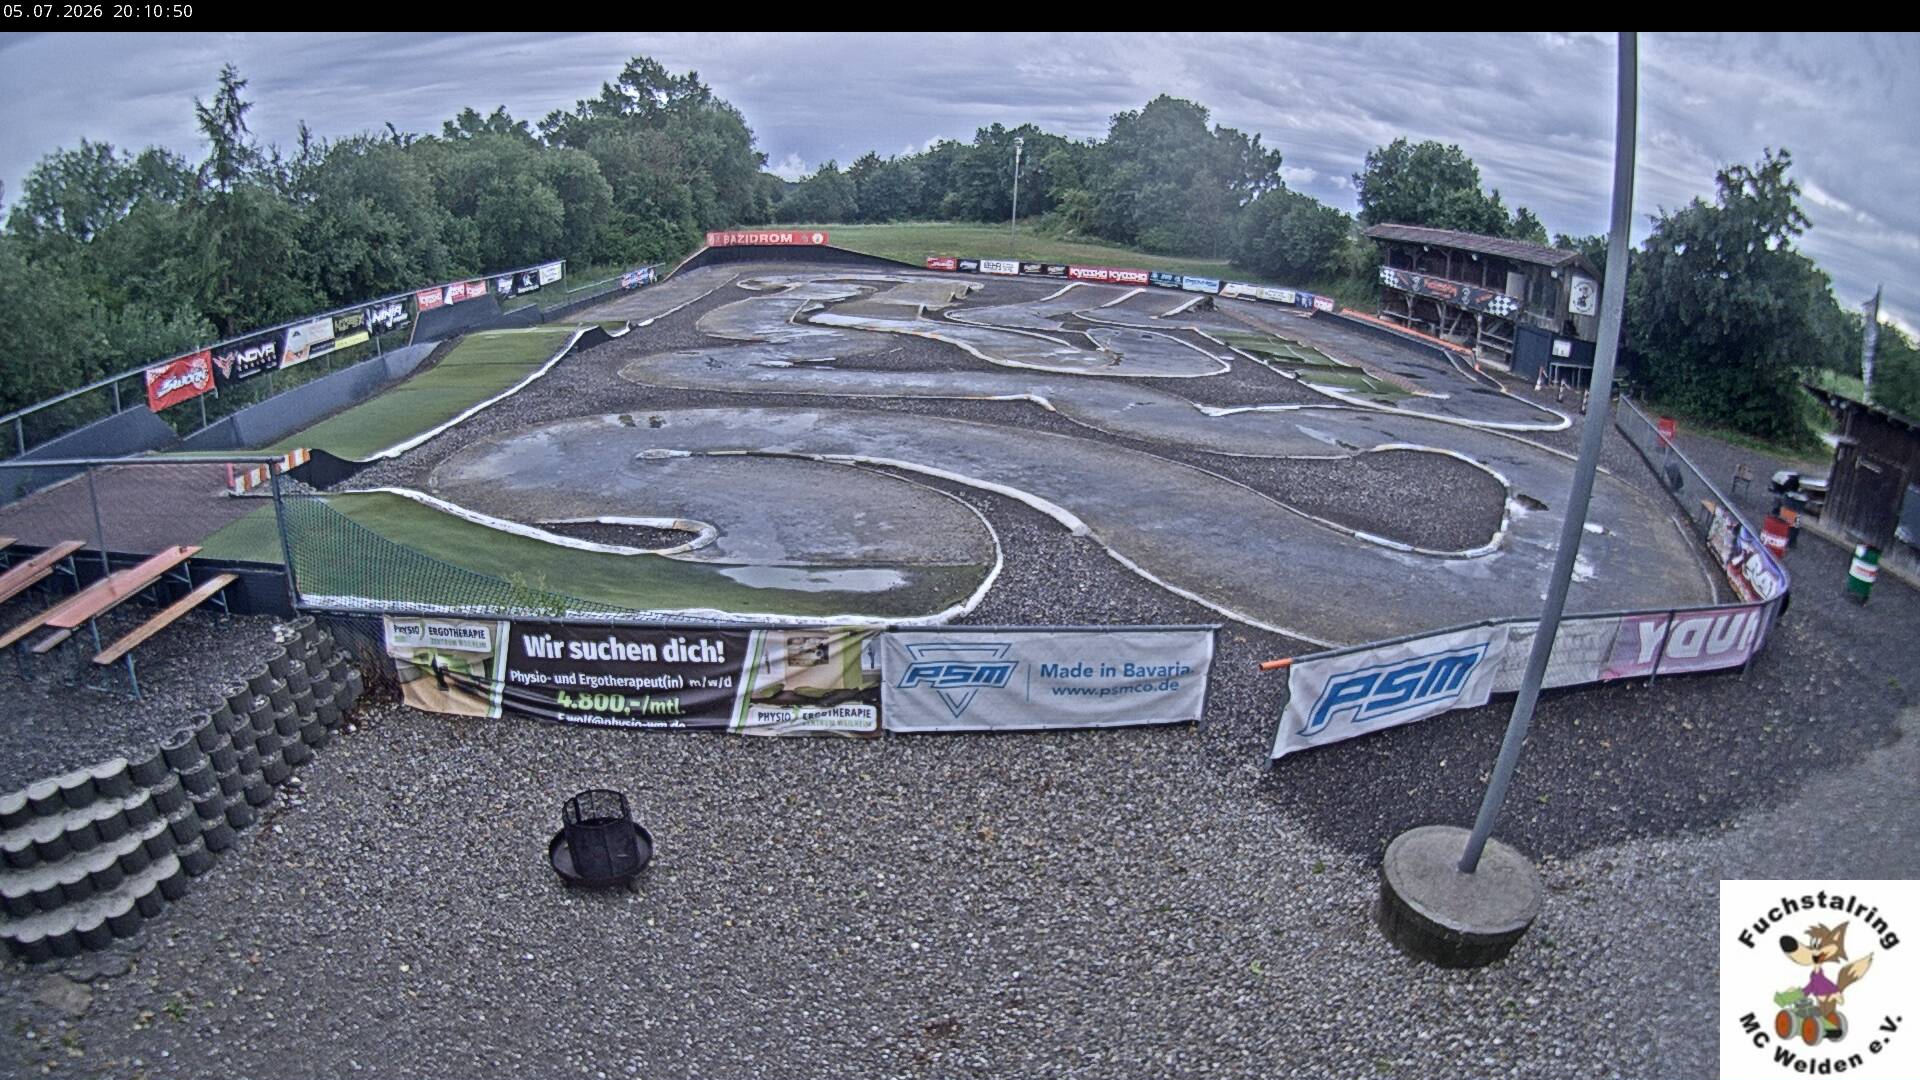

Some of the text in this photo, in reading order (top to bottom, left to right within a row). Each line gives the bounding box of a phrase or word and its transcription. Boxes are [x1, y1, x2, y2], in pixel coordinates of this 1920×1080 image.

[723, 233, 793, 245] BAZIDROM
[1069, 267, 1107, 279] KYOSHO
[1108, 270, 1148, 282] KYOSHO
[394, 624, 486, 640] PHYSIO ERGOTHERAPIE
[523, 634, 726, 664] Wir suchen dich!
[902, 663, 1014, 686] PSM
[1040, 661, 1190, 678] Made in Bavaria
[510, 669, 733, 690] Physio- und Ergotherapeut(in) m/w/d
[1052, 679, 1180, 698] www.psmco.de
[1306, 649, 1484, 731] PSM
[757, 711, 791, 722] PHYSIO
